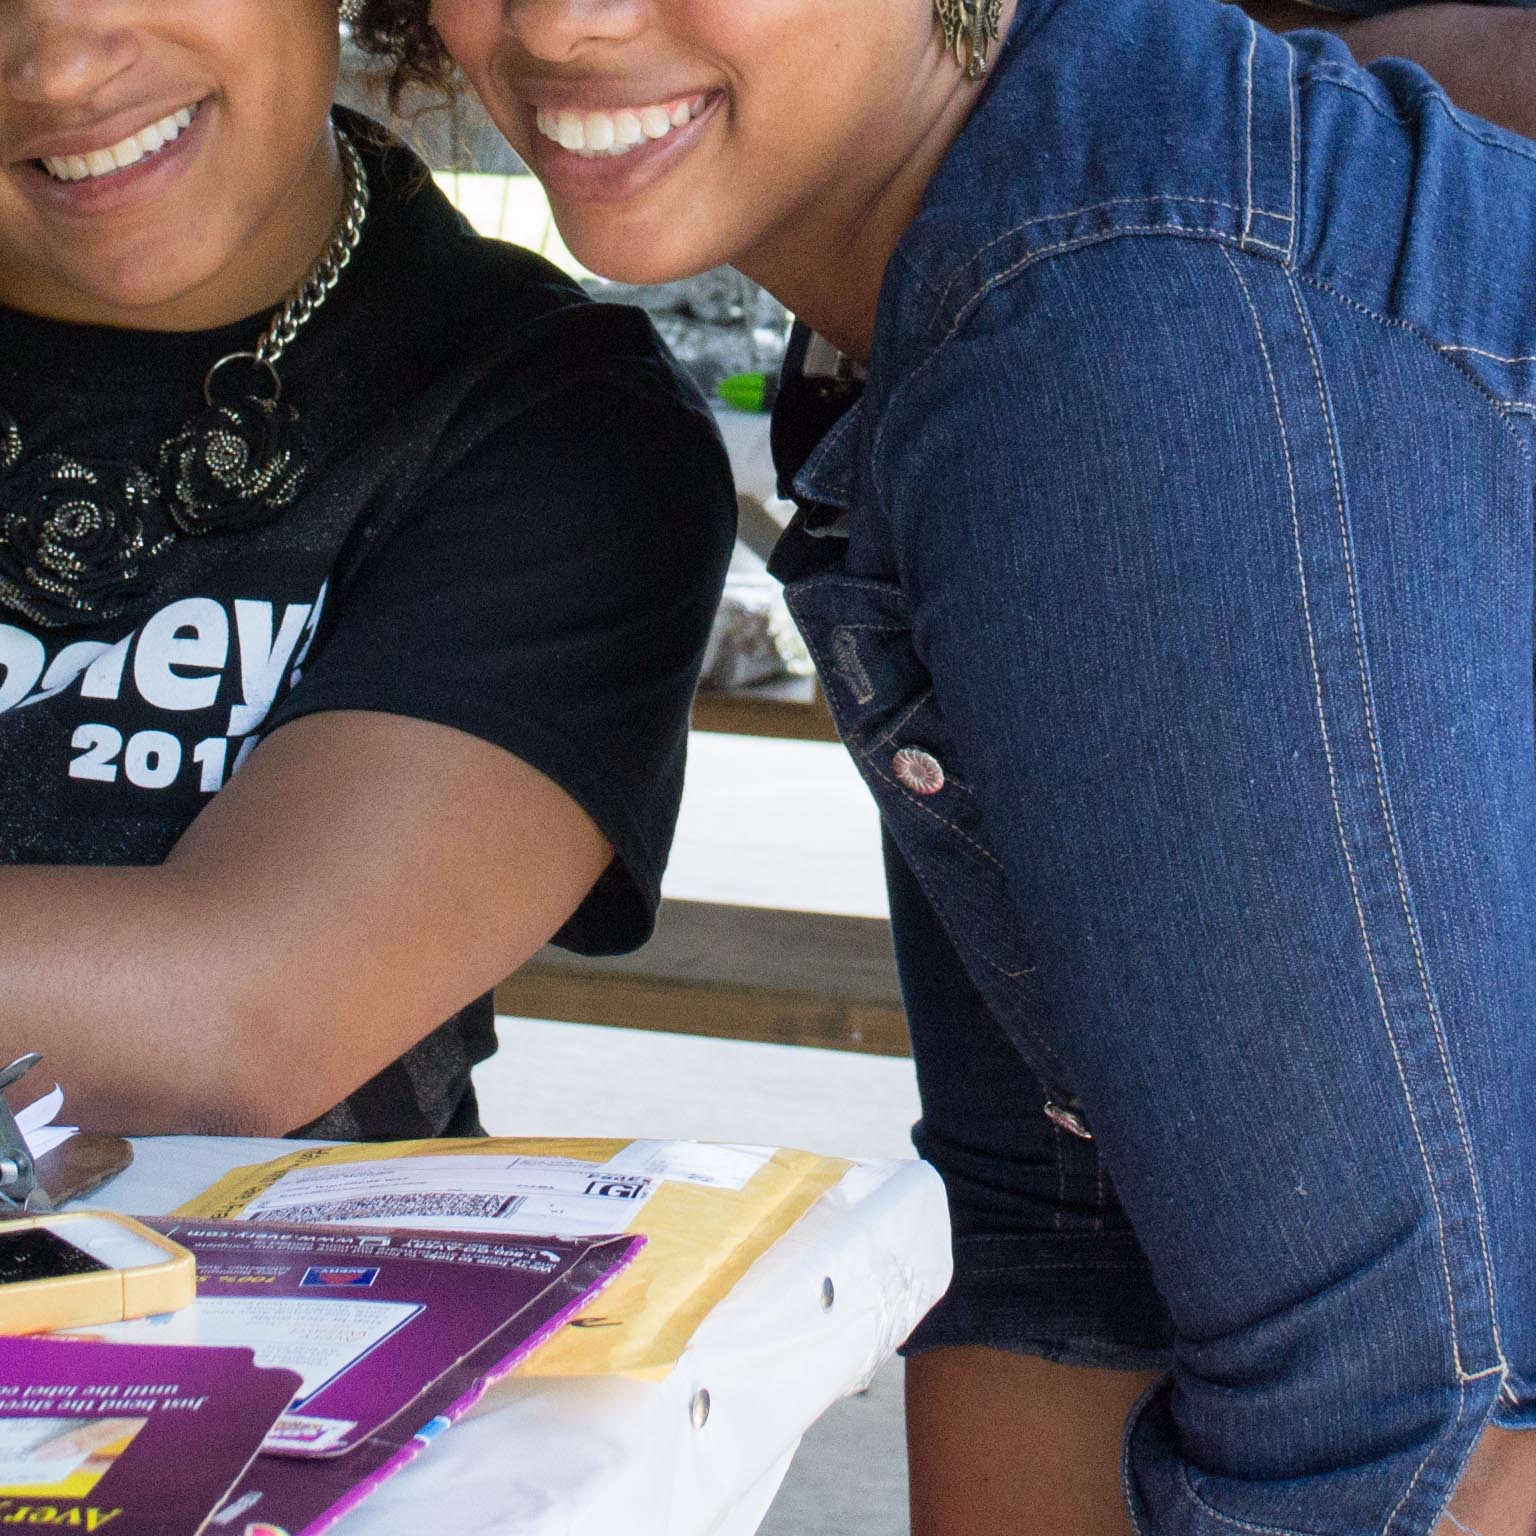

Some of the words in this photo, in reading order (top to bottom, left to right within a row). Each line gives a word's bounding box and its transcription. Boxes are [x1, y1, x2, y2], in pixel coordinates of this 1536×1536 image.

[68, 723, 260, 793] 201
[187, 1231, 354, 1244] www.avery.com
[23, 1385, 79, 1399] label
[83, 1385, 120, 1398] the
[123, 1385, 180, 1398] until
[57, 1399, 95, 1413] the
[97, 1399, 158, 1413] bend
